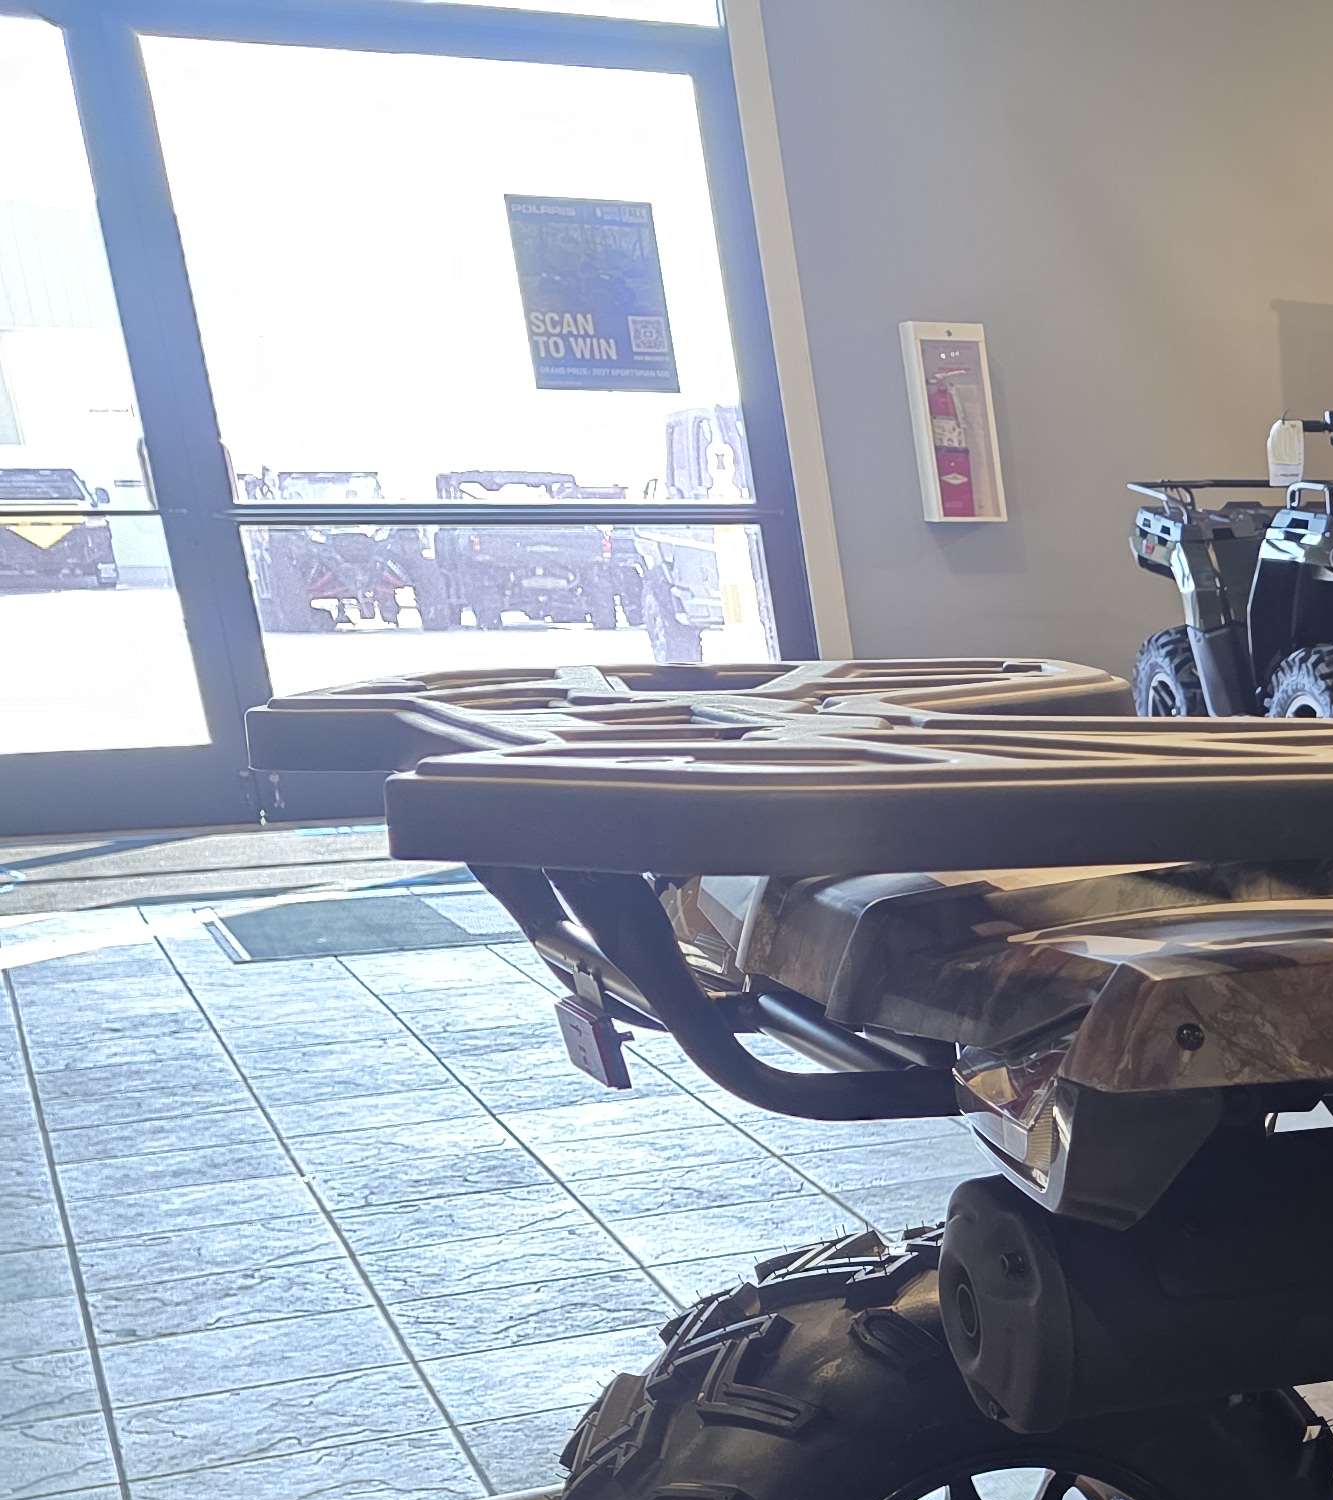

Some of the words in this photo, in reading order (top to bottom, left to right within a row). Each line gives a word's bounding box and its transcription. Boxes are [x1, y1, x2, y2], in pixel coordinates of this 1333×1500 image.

[510, 203, 576, 216] POLARIS
[529, 311, 595, 336] SCAN
[533, 336, 566, 359] TO
[568, 337, 618, 361] WIN
